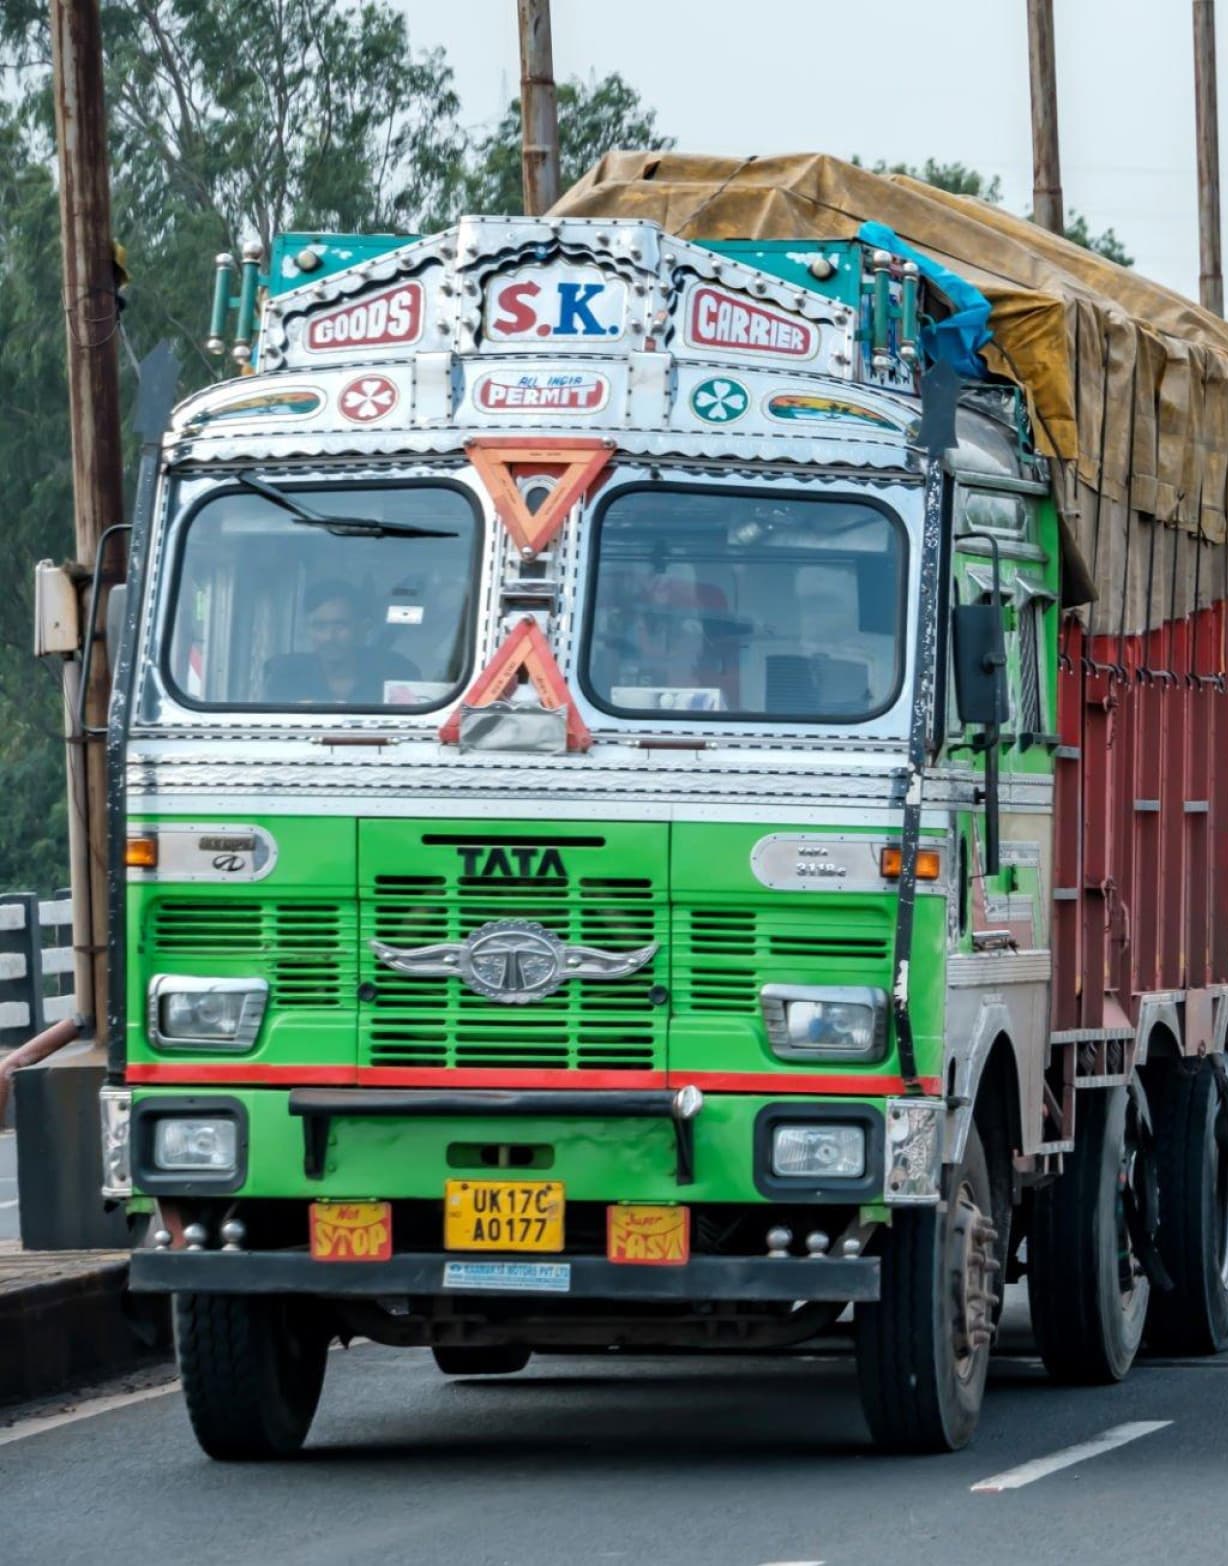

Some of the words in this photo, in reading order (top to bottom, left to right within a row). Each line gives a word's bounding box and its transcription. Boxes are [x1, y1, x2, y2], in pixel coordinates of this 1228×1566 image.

[314, 290, 412, 343] GOODS
[493, 280, 619, 337] S.K.
[697, 294, 805, 351] CARRIER
[487, 383, 597, 406] PERMIT
[457, 847, 568, 877] TATA
[316, 1222, 387, 1256] STOP
[611, 1226, 685, 1260] FAST
